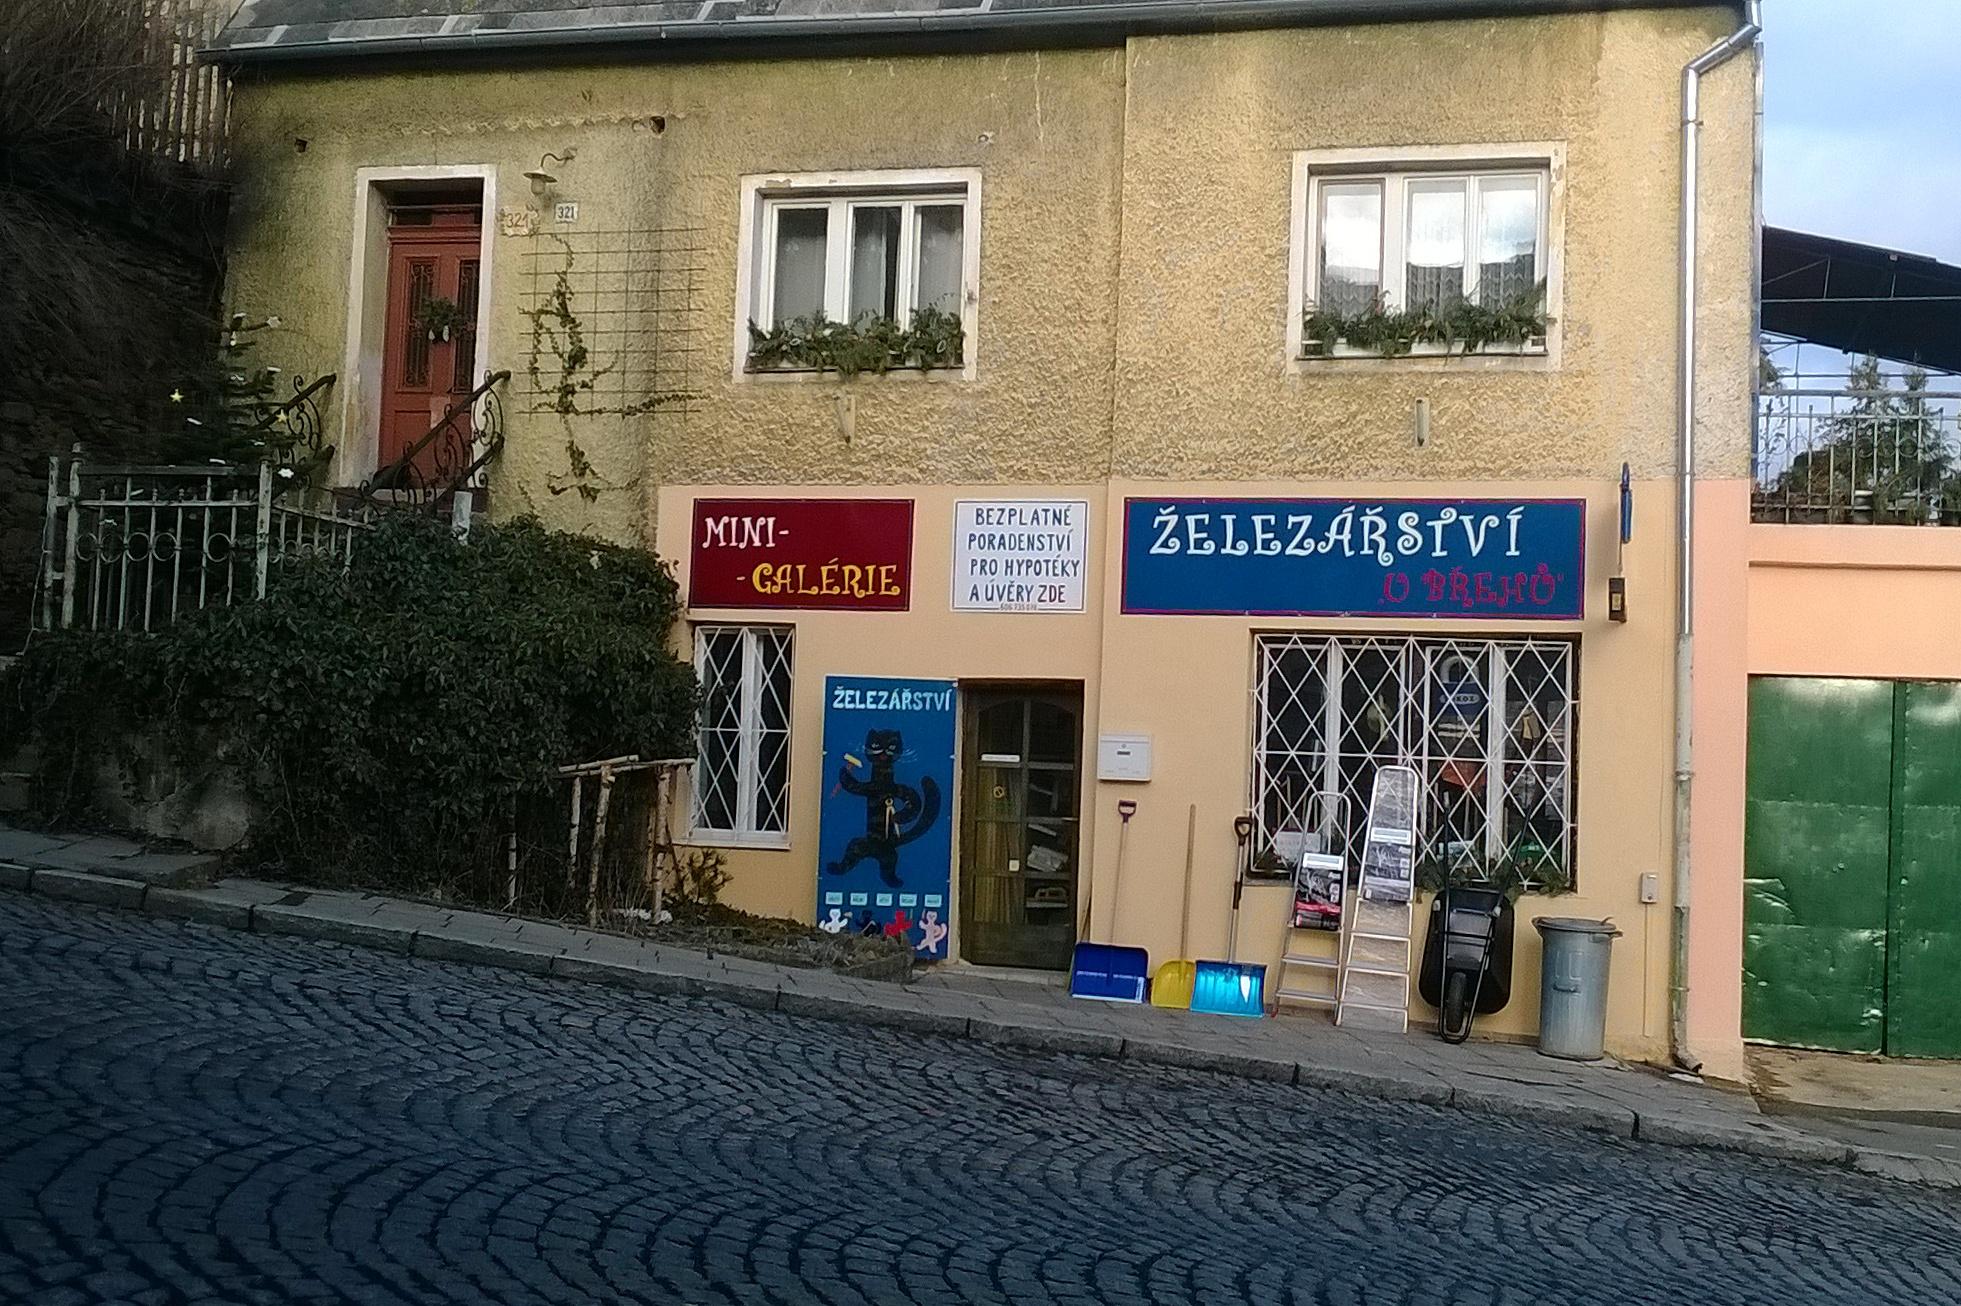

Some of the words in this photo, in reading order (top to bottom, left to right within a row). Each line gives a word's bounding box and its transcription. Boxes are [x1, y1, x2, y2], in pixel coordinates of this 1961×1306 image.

[558, 205, 575, 219] 321
[975, 504, 1072, 526] BEZPLATNÉ
[702, 515, 789, 549] MINI-
[968, 528, 1073, 552] PORADENSTVÍ
[1149, 504, 1525, 567] ŽELEZÁŘSTVÍ
[970, 558, 998, 576] PRO
[1004, 553, 1080, 577] HYPOTÉKY
[969, 583, 980, 602] A
[985, 578, 1034, 602] ÚVĚRY
[1037, 584, 1066, 603] ZDE
[832, 686, 953, 712] ŽELEZÁŘSTVÍ
